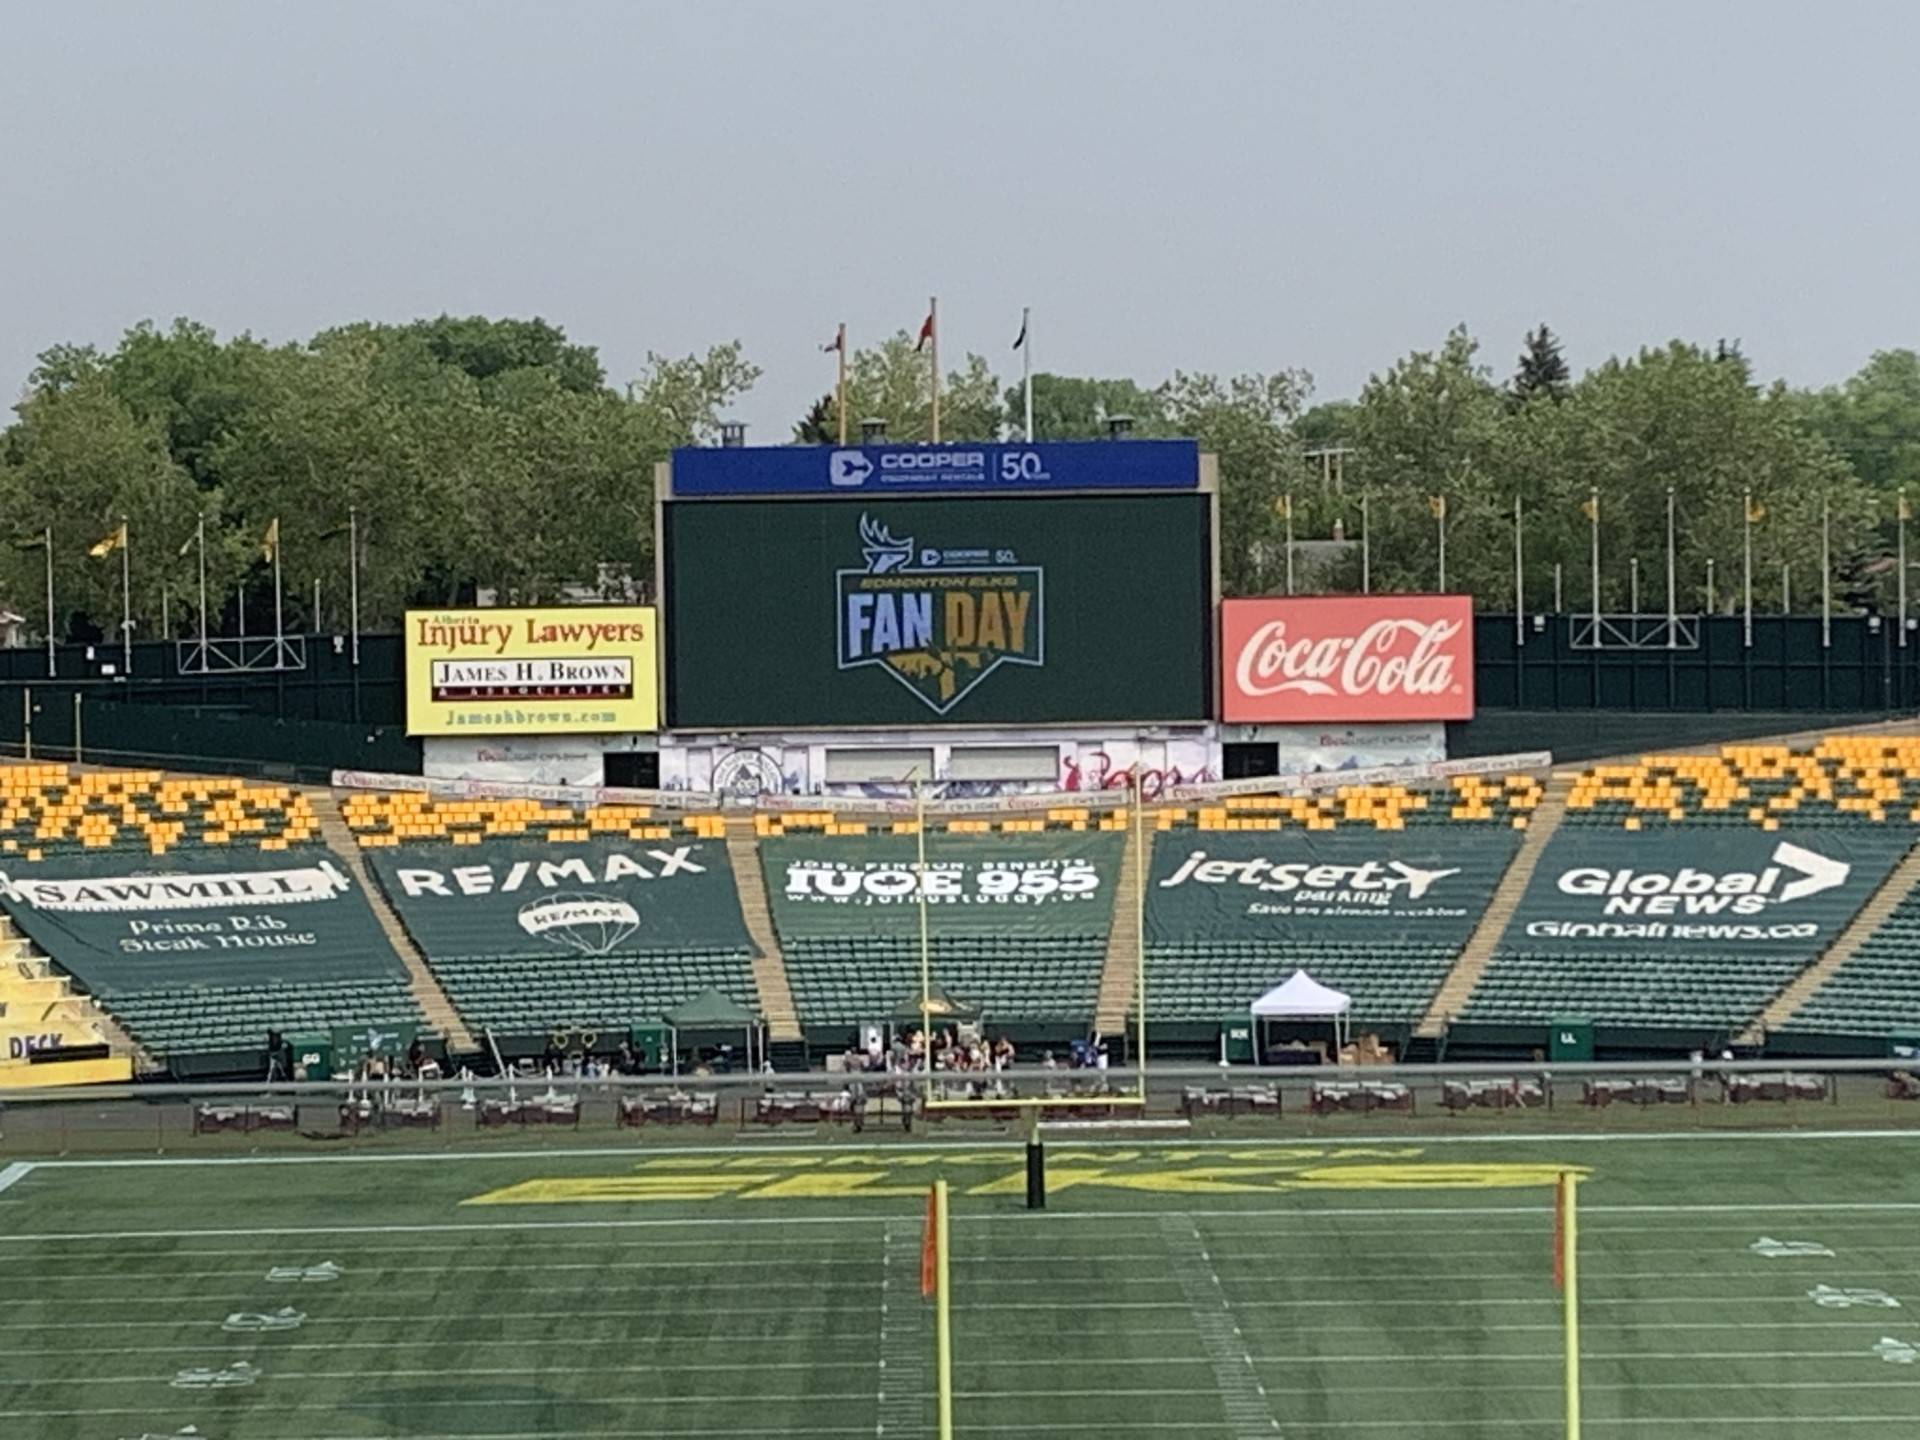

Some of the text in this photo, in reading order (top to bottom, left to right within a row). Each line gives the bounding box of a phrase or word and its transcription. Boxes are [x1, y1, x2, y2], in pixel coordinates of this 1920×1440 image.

[880, 452, 1042, 480] COOPER 50
[417, 618, 644, 654] Injury Lawyers
[848, 591, 1031, 658] FAN DAY
[1236, 618, 1463, 696] Coca-Cola
[439, 661, 626, 683] JAMES H. BROWN
[396, 846, 706, 896] RE/MAX
[785, 865, 1099, 896] IUOE 955
[1159, 851, 1386, 891] jetset
[1557, 866, 1781, 895] Global
[33, 877, 313, 902] SAWMILL
[534, 908, 622, 925] RE/MAX
[1603, 895, 1767, 916] NEWS
[128, 913, 288, 936] Prime Rib
[119, 932, 317, 953] Steak House
[9, 1033, 64, 1058] DECK
[460, 1163, 1594, 1205] ELKS
